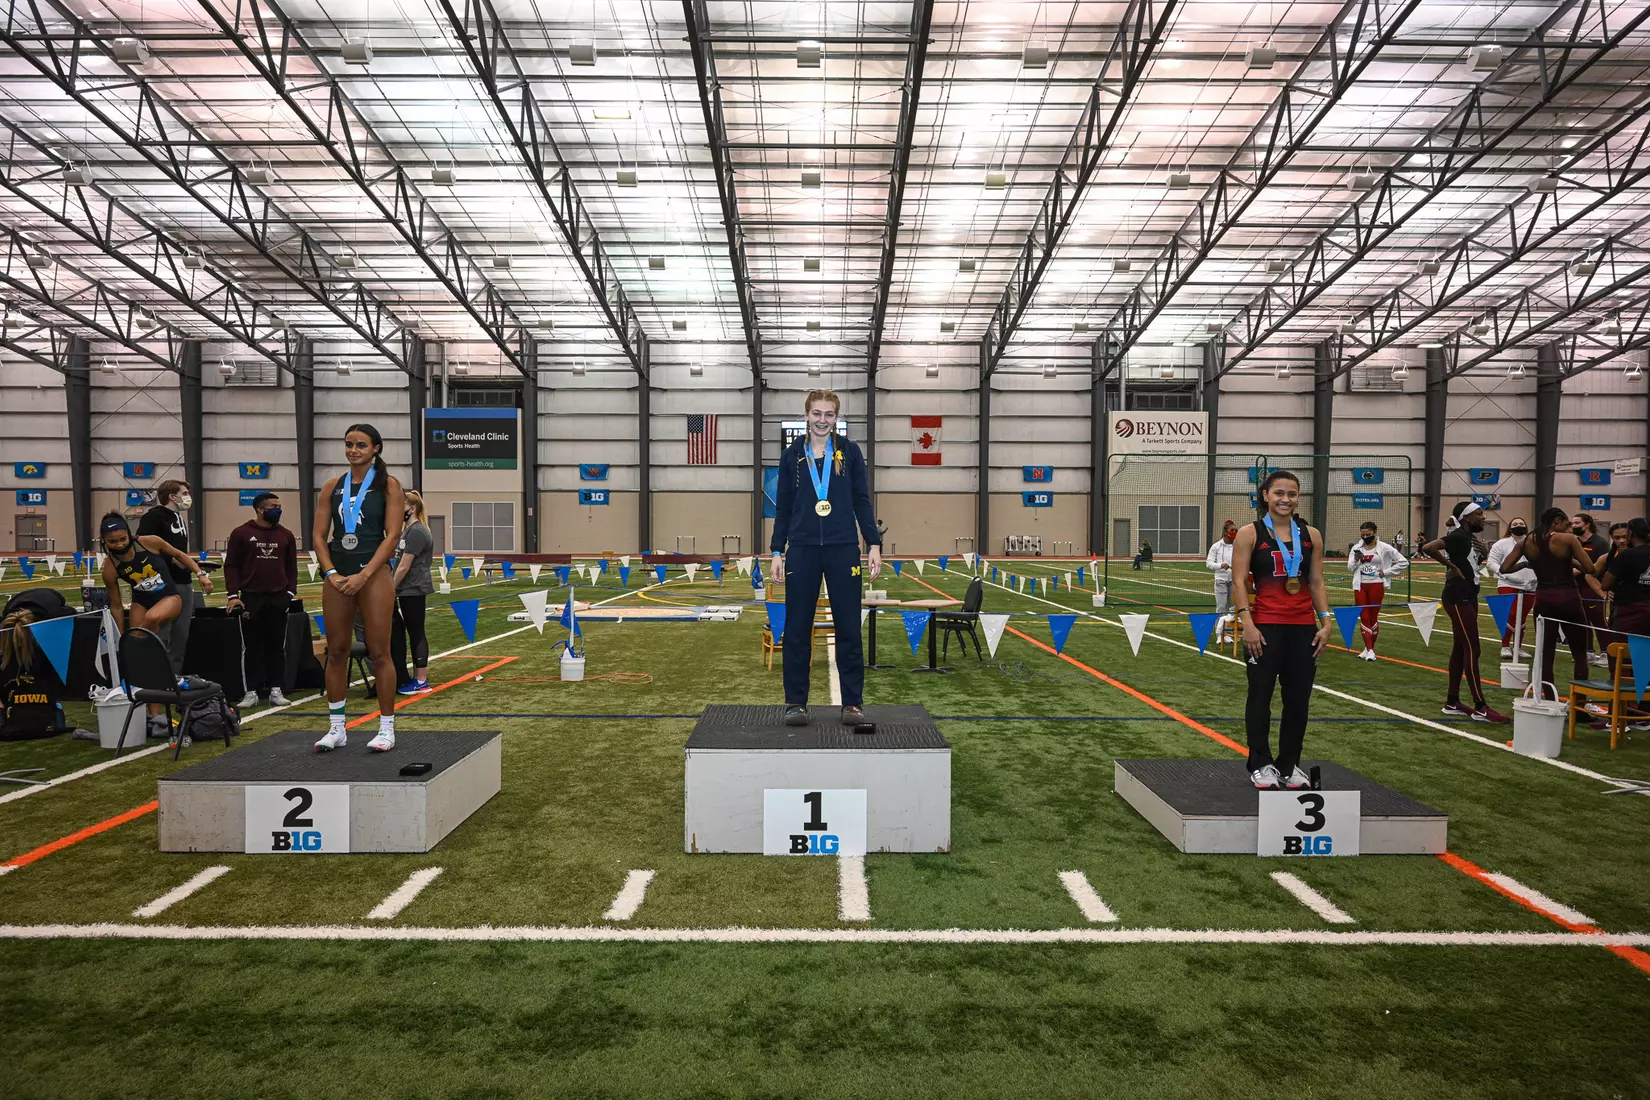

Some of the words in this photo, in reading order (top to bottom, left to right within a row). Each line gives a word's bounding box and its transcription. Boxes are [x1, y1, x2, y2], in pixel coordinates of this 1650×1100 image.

[1136, 421, 1203, 436] BEYNON
[447, 432, 486, 441] Cleveland
[487, 432, 509, 441] Clinic
[246, 465, 260, 475] M
[448, 461, 494, 469] sports-health.org
[1032, 468, 1043, 479] N
[1478, 471, 1493, 480] P
[1589, 471, 1600, 481] R
[851, 566, 861, 576] M
[14, 694, 48, 704] IOWA
[282, 787, 313, 828] 2
[803, 791, 828, 831] 1
[1293, 793, 1325, 832] 3
